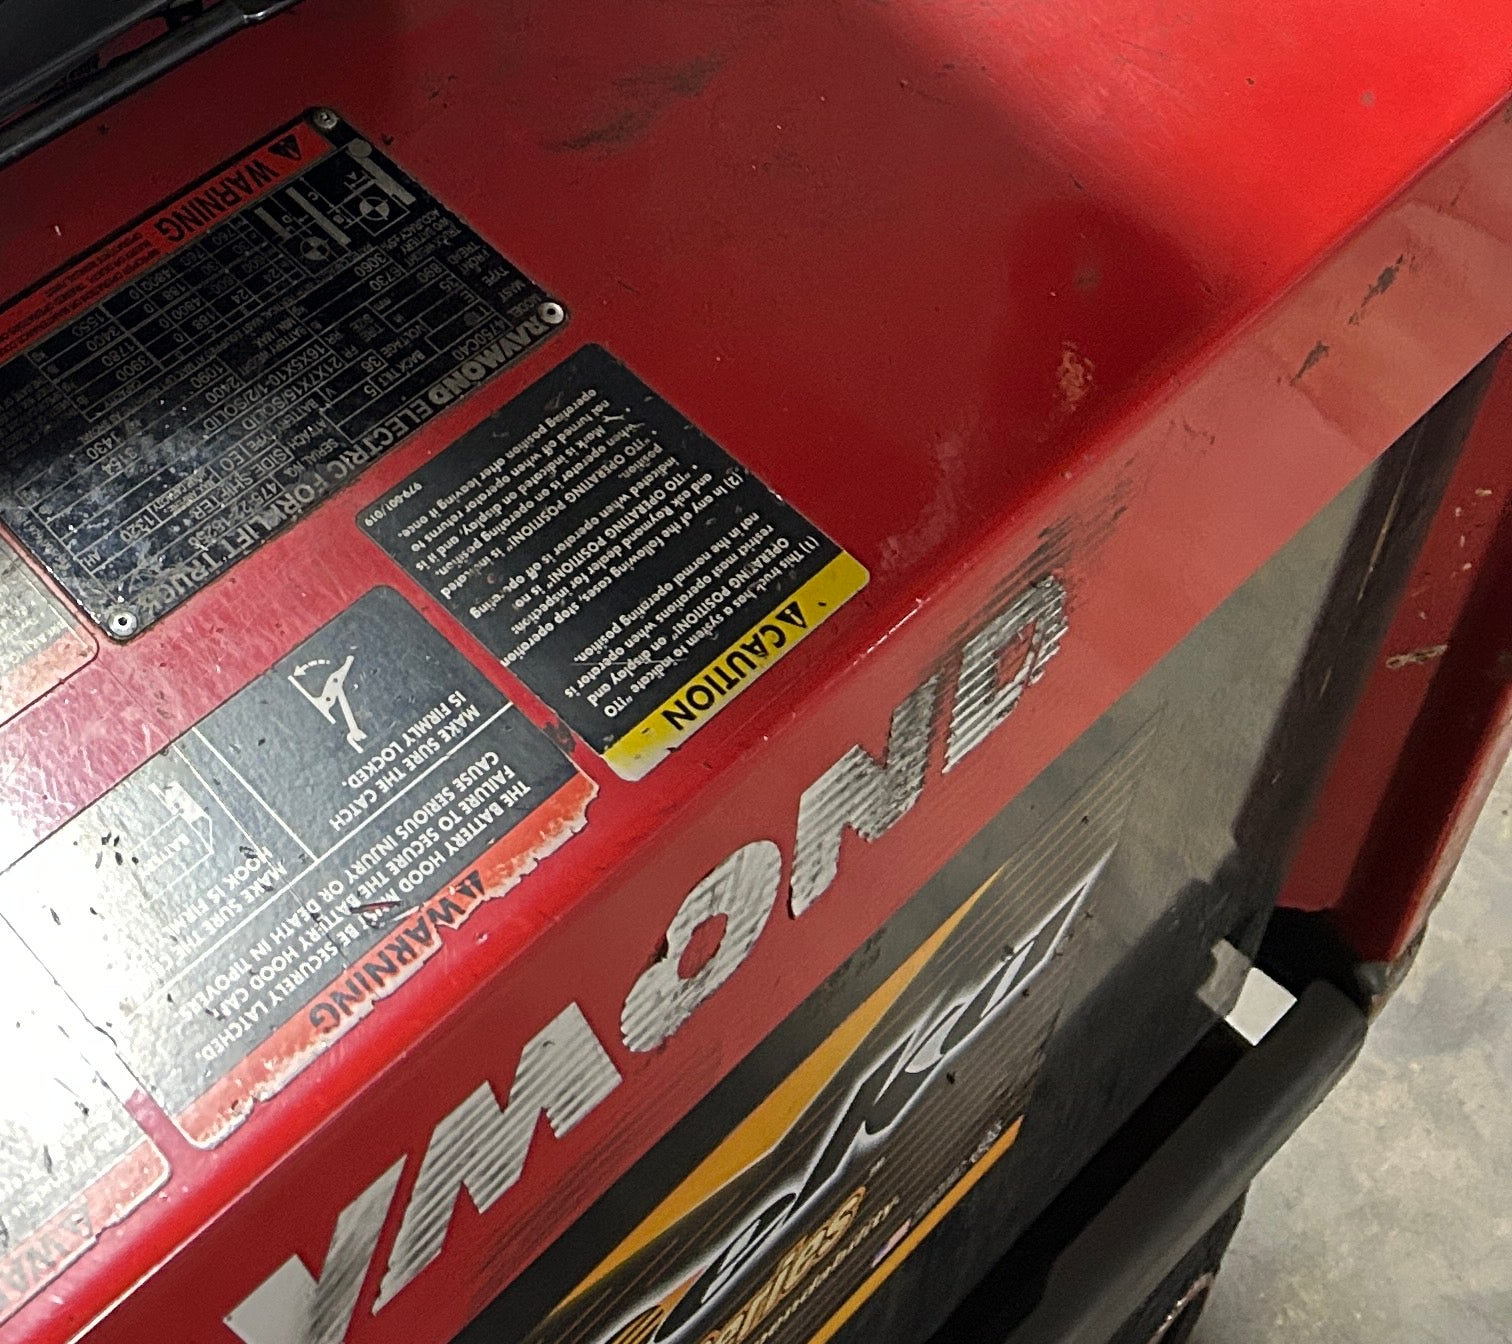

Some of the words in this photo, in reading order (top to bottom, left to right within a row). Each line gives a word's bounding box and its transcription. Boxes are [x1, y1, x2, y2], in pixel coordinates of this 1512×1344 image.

[151, 155, 281, 244] WARNING
[424, 313, 548, 408] RAYMOND
[543, 385, 599, 429] operating
[590, 398, 612, 416] not
[322, 396, 433, 481] ELECTRIC
[502, 423, 549, 461] position
[556, 413, 594, 443] turned
[574, 423, 608, 450] Mark
[250, 446, 288, 476] SIDE
[510, 451, 544, 478] when
[540, 439, 559, 455] off
[477, 456, 508, 481] after
[516, 454, 568, 495] indicated
[627, 454, 679, 496] indicated
[689, 472, 715, 493] and
[721, 470, 744, 489] (2)
[435, 475, 481, 512] leaving
[461, 473, 513, 514] operator
[597, 491, 632, 520] when
[670, 489, 694, 509] ask
[688, 492, 714, 513] any
[711, 484, 728, 498] In
[117, 512, 156, 544] 1320
[396, 514, 429, 541] once.
[424, 510, 466, 544] returns
[457, 501, 505, 539] display,
[602, 487, 667, 539] OPERATING
[618, 503, 674, 548] Raymond
[659, 520, 683, 540] the
[677, 510, 695, 525] of
[739, 511, 763, 531] not
[436, 535, 462, 557] and
[549, 513, 602, 557] operator
[709, 536, 732, 555] the
[736, 523, 777, 557] restrict
[798, 535, 821, 554] (1)
[523, 560, 545, 579] off
[585, 544, 625, 576] dealer
[608, 533, 665, 580] following
[671, 551, 714, 586] normal
[710, 553, 742, 579] mast
[779, 550, 805, 571] This
[567, 571, 590, 591] for
[575, 573, 612, 603] cases,
[652, 572, 715, 625] operations
[507, 584, 572, 637] inspection:
[550, 599, 582, 626] stop
[618, 580, 676, 628] operating
[732, 589, 757, 611] has
[496, 619, 557, 670] operation
[570, 622, 624, 667] position.
[623, 620, 659, 650] when
[684, 612, 727, 649] system
[572, 643, 628, 690] operator
[607, 647, 654, 687] display
[629, 655, 677, 696] indicate
[659, 619, 792, 733] CAUTION
[446, 689, 468, 709] IS
[585, 682, 614, 707] and
[398, 701, 452, 747] FIRMLY
[436, 703, 482, 743] MAKE
[340, 740, 404, 795] LOCKED.
[401, 736, 441, 771] SURE
[451, 748, 501, 792] CAUSE
[374, 764, 406, 793] THE
[456, 763, 516, 815] FAILURE
[498, 777, 531, 807] THE
[327, 786, 379, 832] CATCH
[393, 785, 456, 841] SERIOUS
[435, 807, 462, 833] TO
[441, 800, 504, 856] BATTERY
[341, 833, 398, 884] INJURY
[384, 826, 441, 876] SECURE
[356, 868, 390, 900] THE
[395, 849, 446, 895] HOOD
[317, 877, 346, 904] OR
[268, 897, 322, 946] DEATH
[294, 892, 362, 952] BATTERY
[332, 922, 360, 949] BE
[248, 938, 273, 962] IN
[303, 891, 466, 1038] WARNING
[246, 944, 300, 993] HOOD
[264, 938, 341, 1007] SECURELY
[193, 999, 270, 1068] LATCHED.
